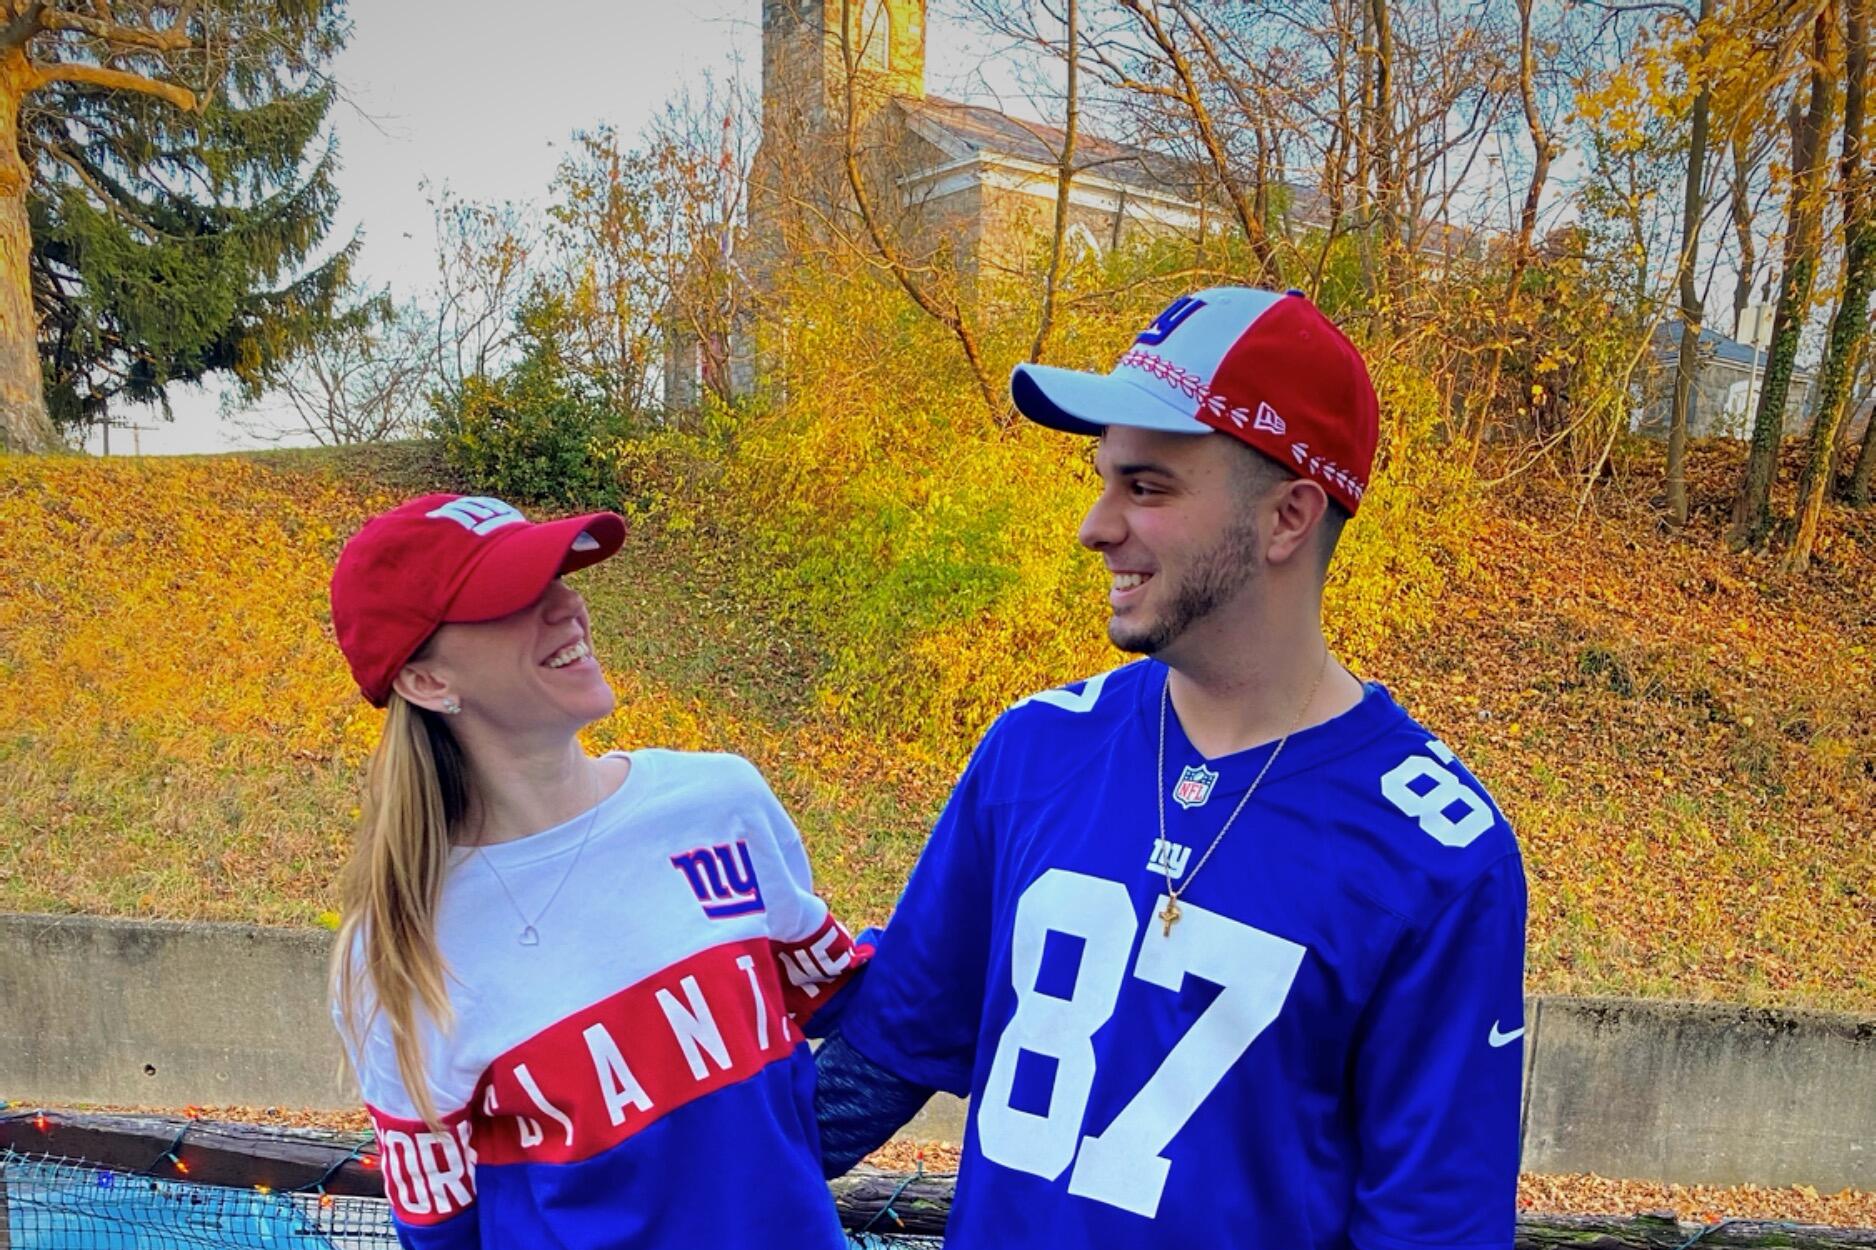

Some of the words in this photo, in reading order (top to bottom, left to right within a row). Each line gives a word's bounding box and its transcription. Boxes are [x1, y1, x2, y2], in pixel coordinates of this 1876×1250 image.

[1380, 739, 1495, 848] 8
[977, 868, 1307, 1219] 87
[371, 1115, 478, 1214] ORK
